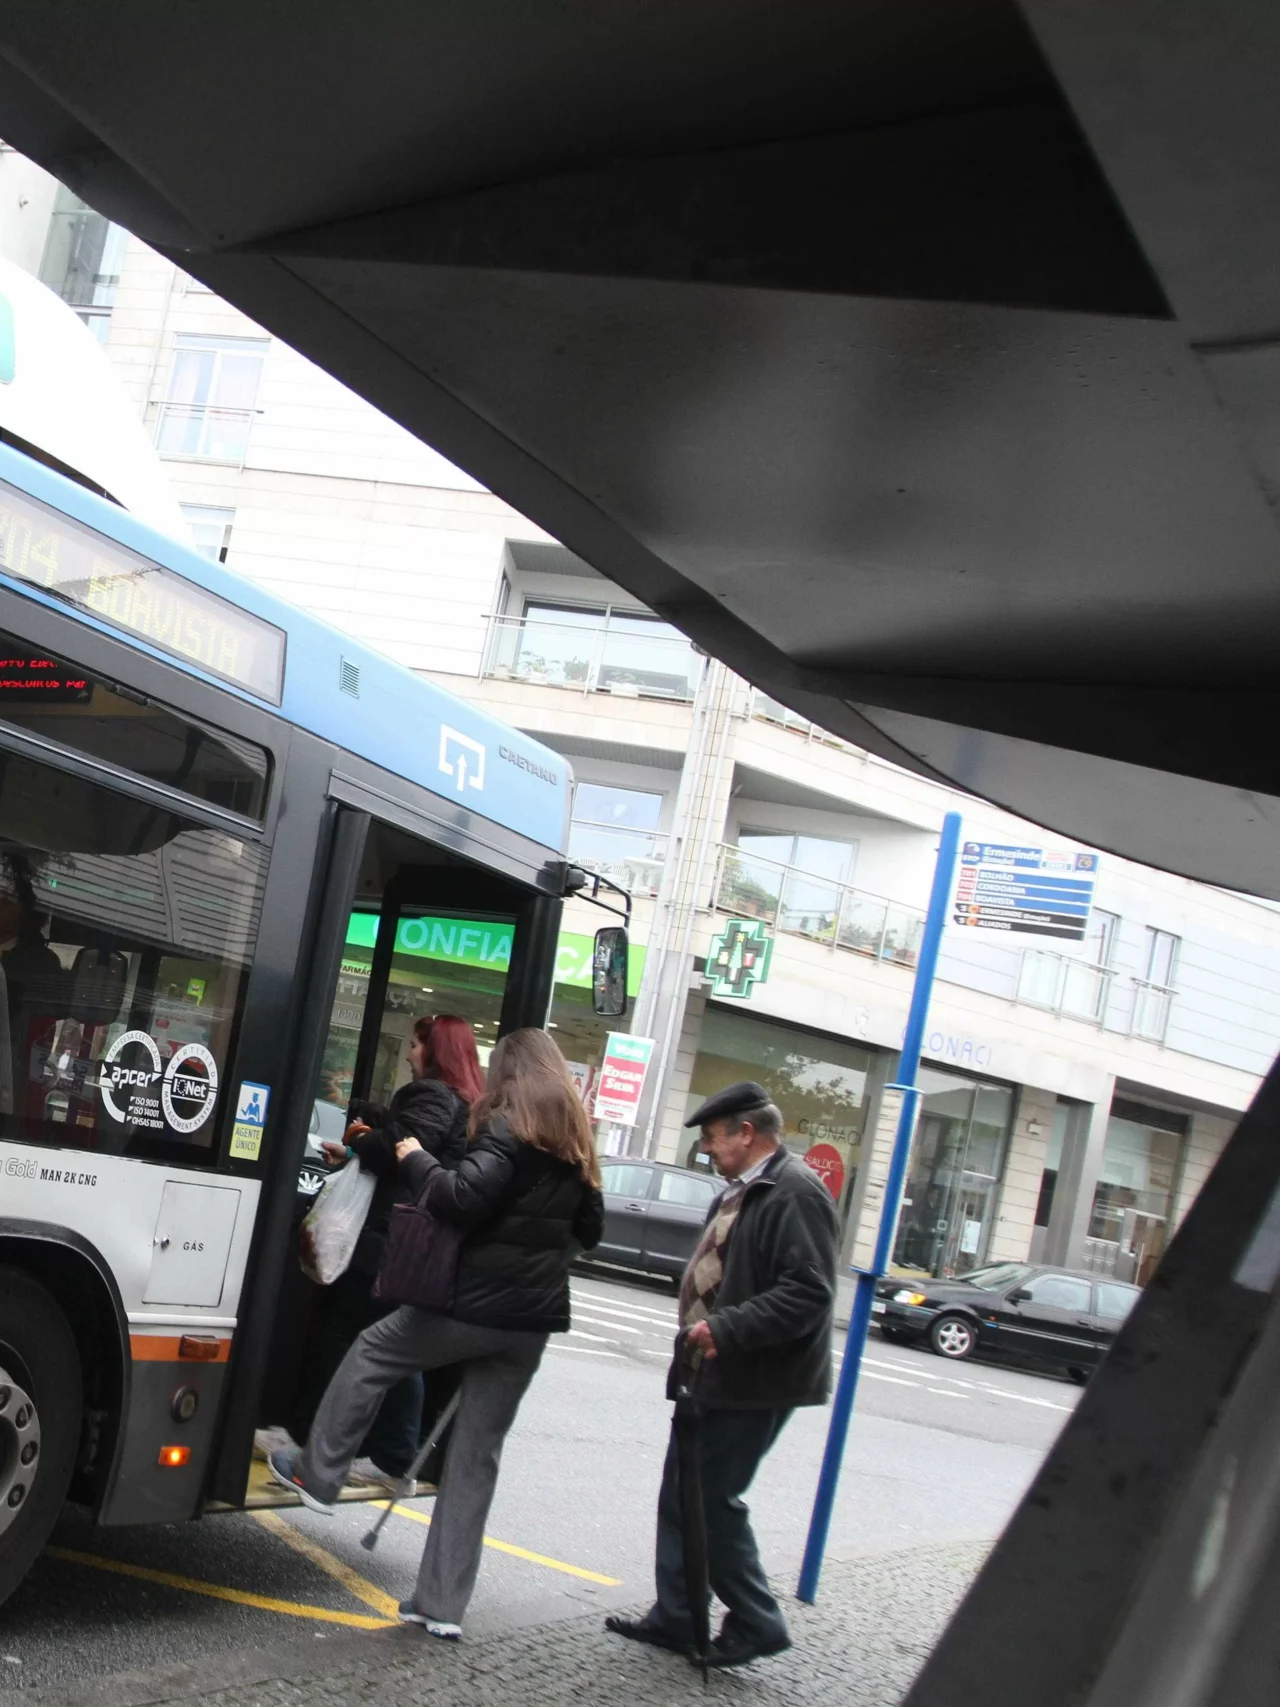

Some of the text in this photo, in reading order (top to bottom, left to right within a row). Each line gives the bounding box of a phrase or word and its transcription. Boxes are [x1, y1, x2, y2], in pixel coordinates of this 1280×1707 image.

[498, 745, 558, 785] CAETANO
[983, 846, 1041, 861] Ermesinde
[170, 1046, 216, 1078] CERTIFIED
[111, 1065, 151, 1090] apcer
[173, 1077, 206, 1098] IQNet
[135, 1096, 159, 1108] ISO 9001
[164, 1090, 213, 1130] MANAGEMENT SYSTEM
[133, 1106, 160, 1118] ISO 14001
[235, 1127, 260, 1140] AGENTE
[235, 1137, 256, 1151] ÚNICO
[5, 1157, 38, 1179] Gold
[40, 1168, 62, 1182] MAN
[64, 1171, 77, 1184] 2K
[79, 1173, 98, 1187] CNG
[183, 1239, 204, 1252] GÁS
